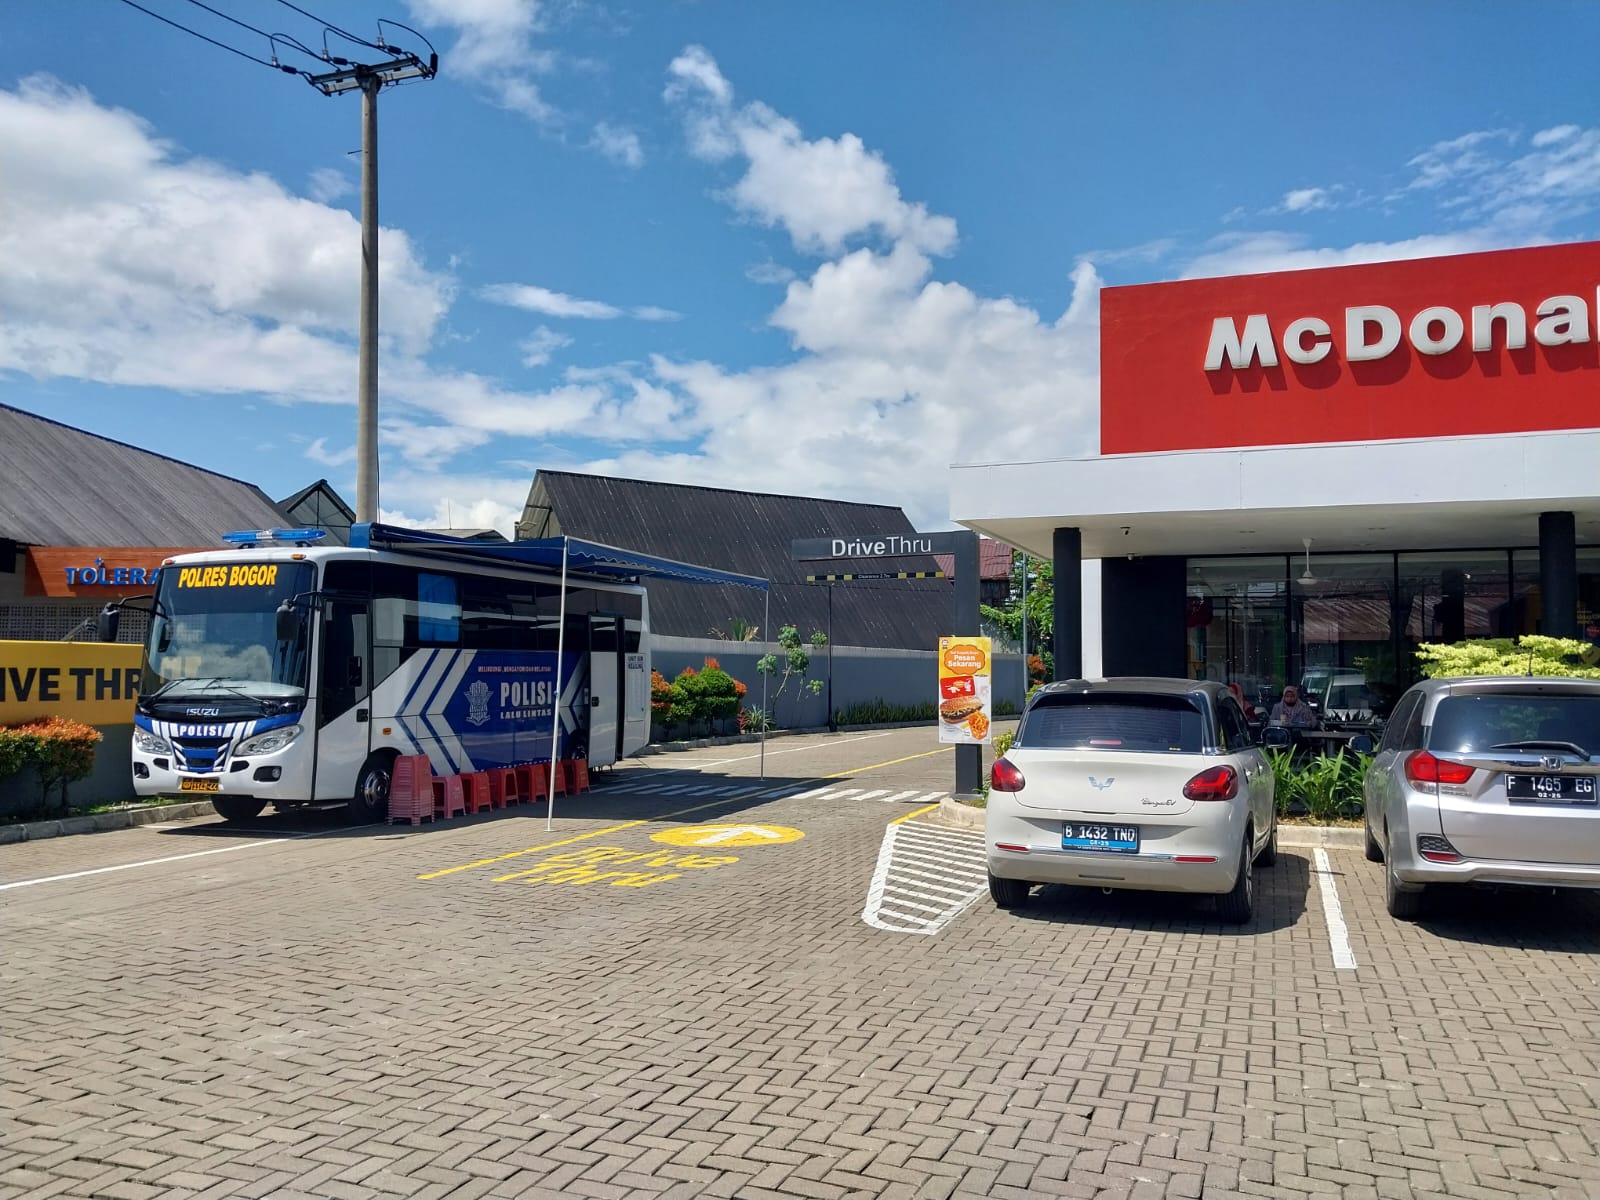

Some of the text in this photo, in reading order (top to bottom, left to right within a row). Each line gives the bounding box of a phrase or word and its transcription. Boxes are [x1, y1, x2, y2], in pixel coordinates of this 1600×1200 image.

[1204, 286, 1600, 371] McDona
[178, 565, 277, 588] POLRES BOGOR
[947, 660, 982, 669] Sekarang
[500, 681, 552, 707] POLISI
[186, 708, 219, 716] ISUZU
[500, 709, 552, 719] LALU LINTAS
[180, 725, 222, 737] POLISI
[1508, 776, 1592, 793] F 1465 EG
[1065, 825, 1073, 838] B
[1077, 826, 1108, 840] 1432
[545, 846, 740, 869] Drive
